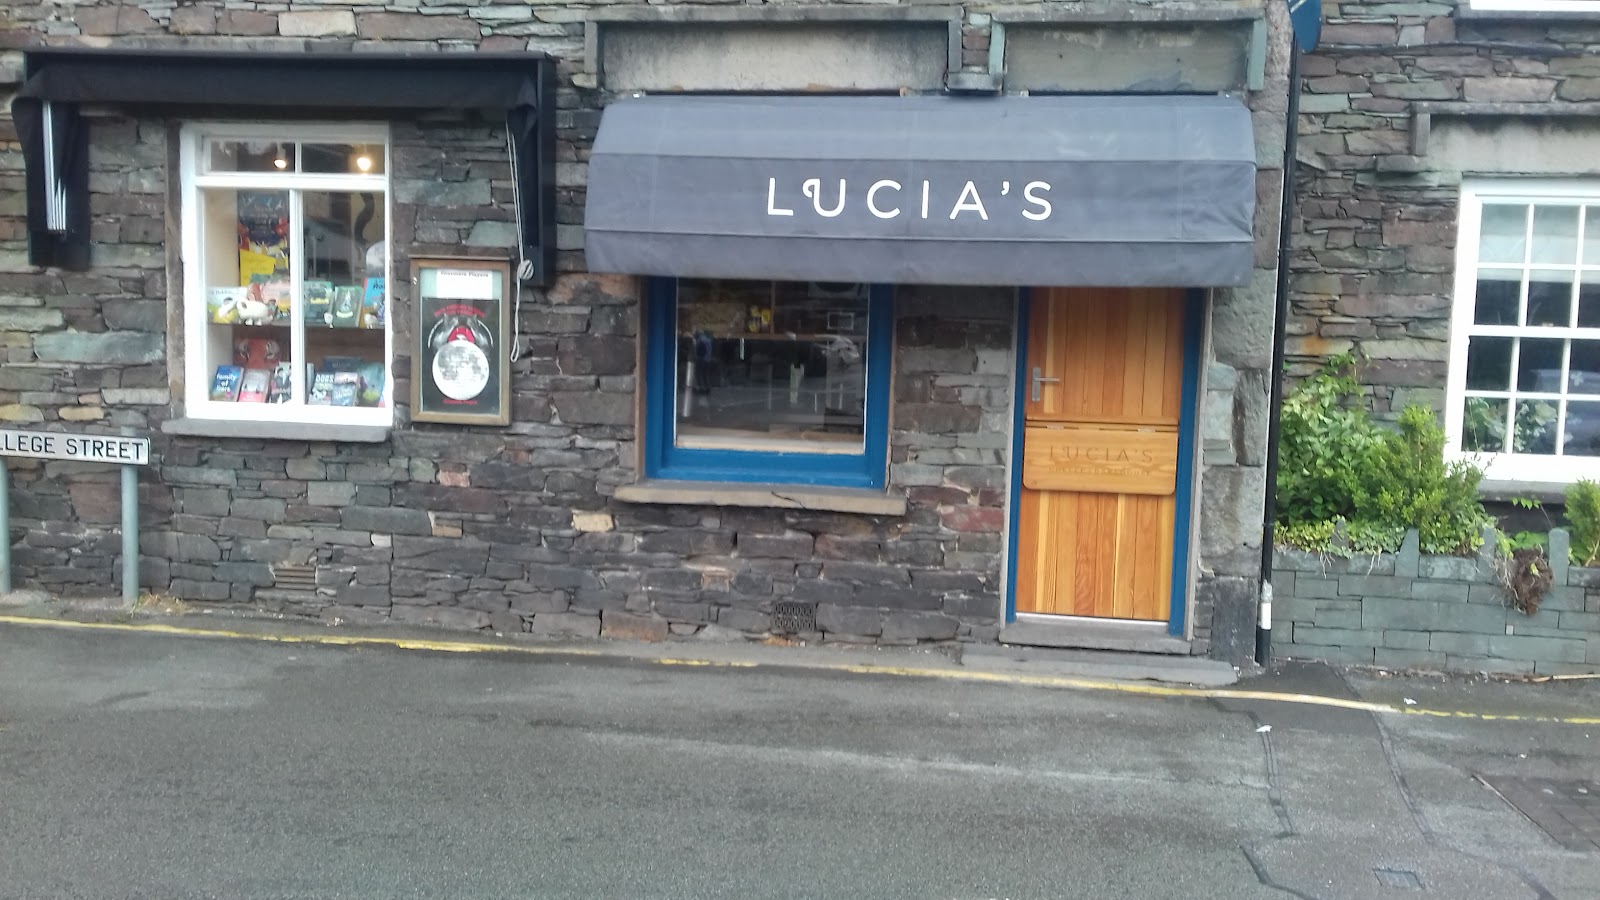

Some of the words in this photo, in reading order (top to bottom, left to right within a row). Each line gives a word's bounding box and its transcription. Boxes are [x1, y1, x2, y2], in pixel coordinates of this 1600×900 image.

[767, 177, 1052, 221] LUCIA'S
[0, 434, 55, 454] LEGE
[66, 438, 143, 460] STREET
[1050, 445, 1153, 463] LUCIA'S
